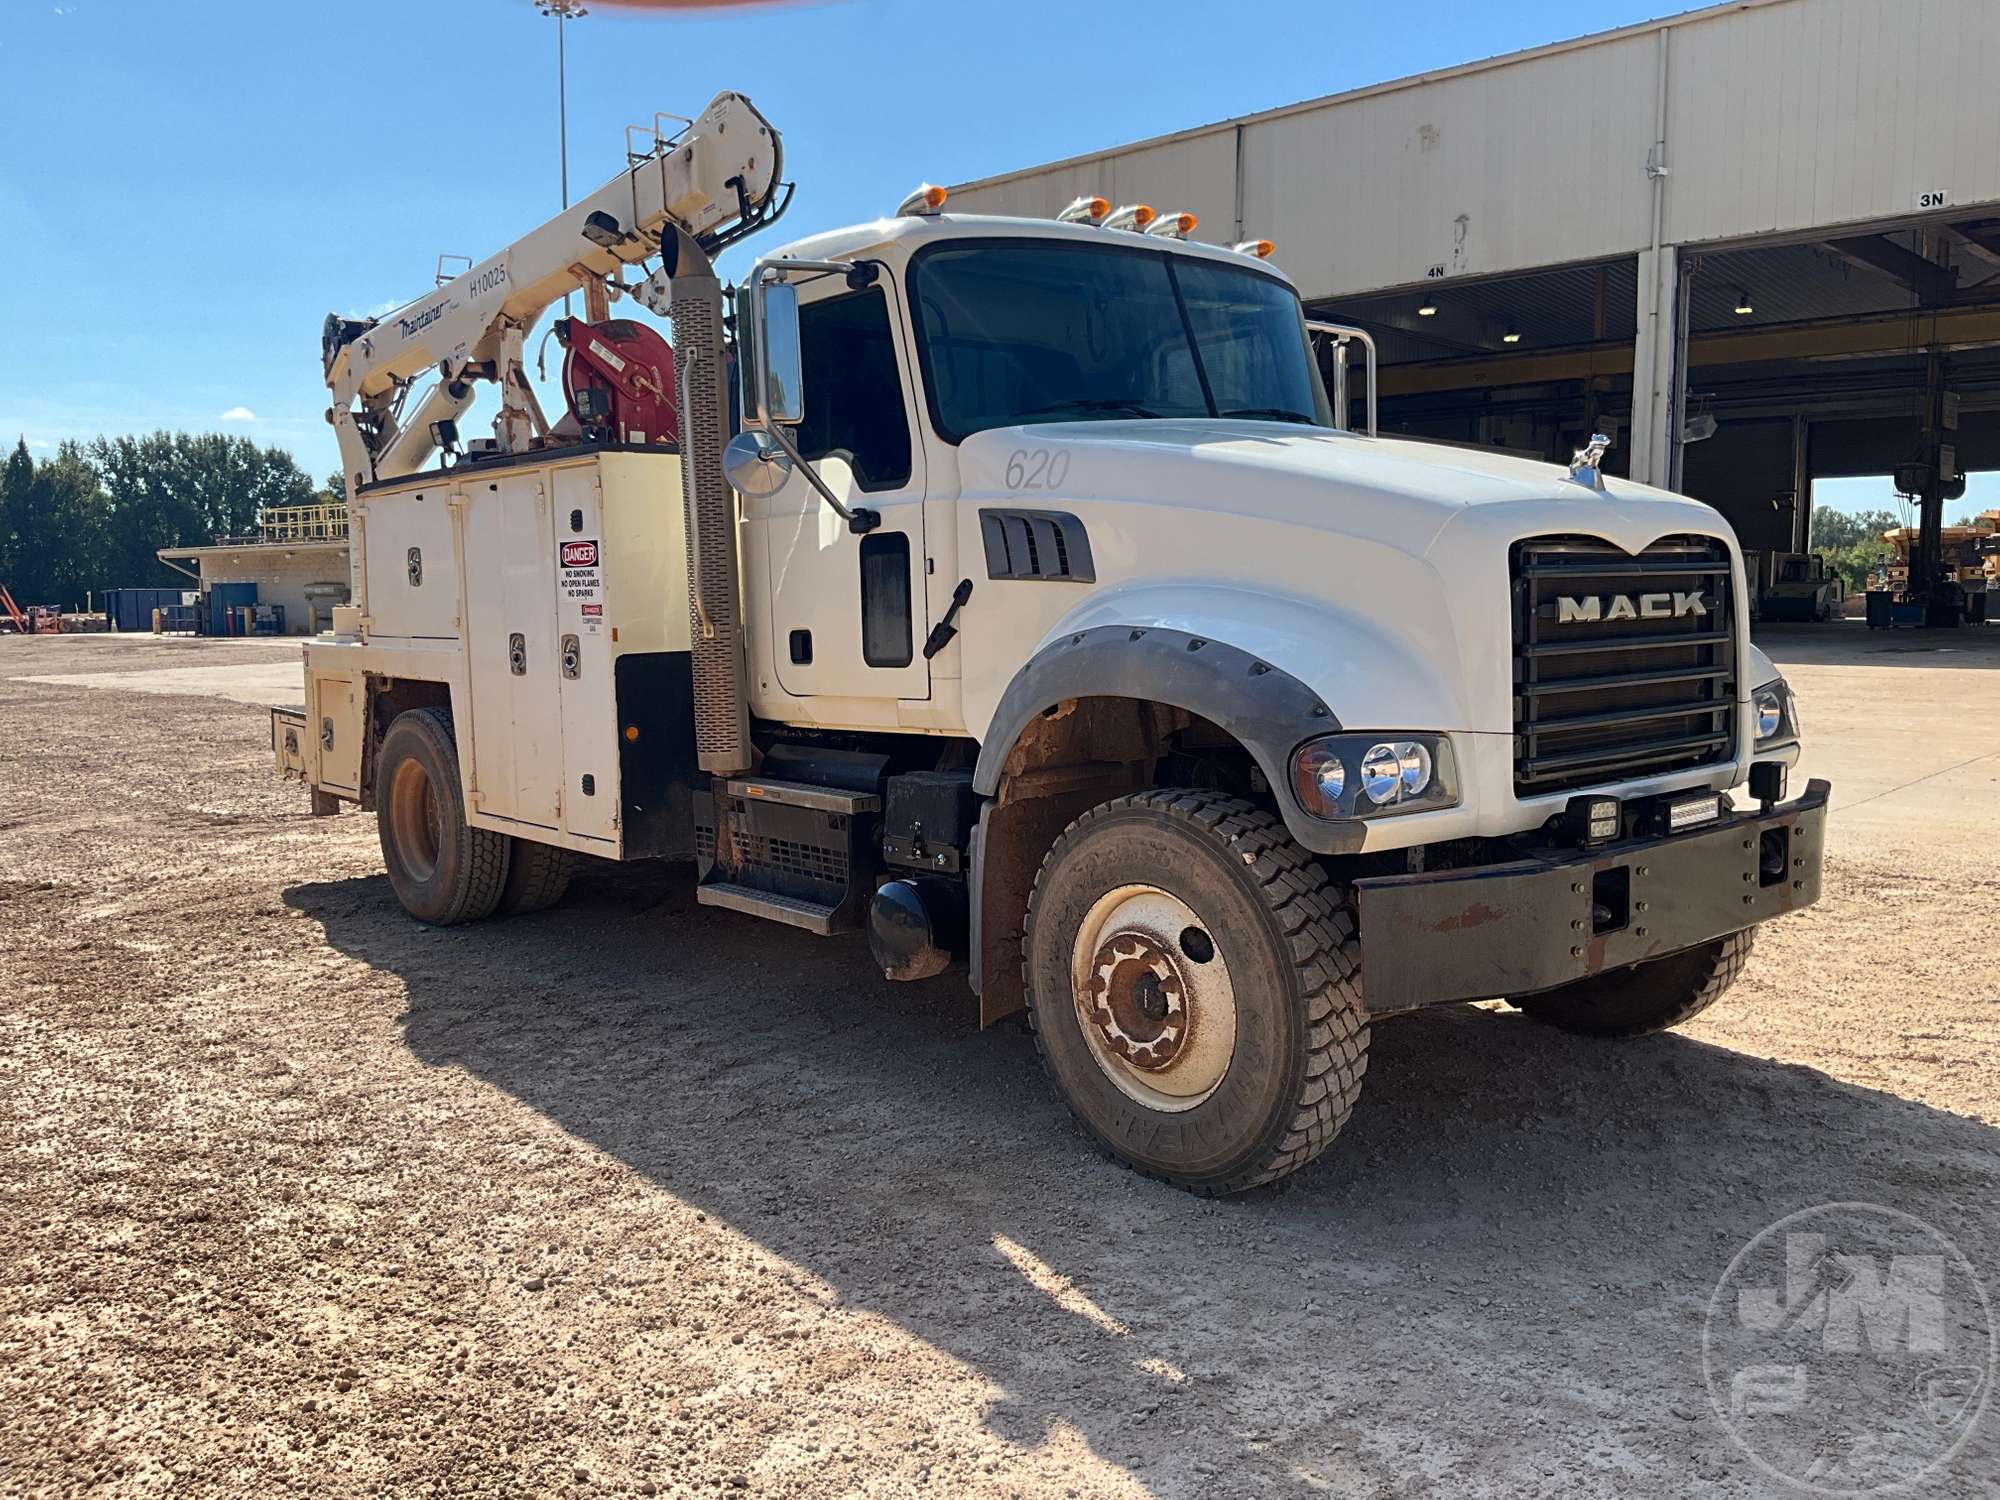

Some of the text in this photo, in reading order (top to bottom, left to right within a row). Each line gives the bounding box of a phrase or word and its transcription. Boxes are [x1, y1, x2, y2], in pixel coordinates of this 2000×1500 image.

[1920, 192, 1943, 207] 3N
[1428, 266, 1444, 278] 4N
[469, 264, 506, 299] H10025
[1005, 448, 1072, 490] 620
[564, 547, 595, 561] DANGER
[574, 570, 594, 578] SMOKING
[582, 580, 600, 588] FLAMES
[1557, 592, 1707, 624] MACK
